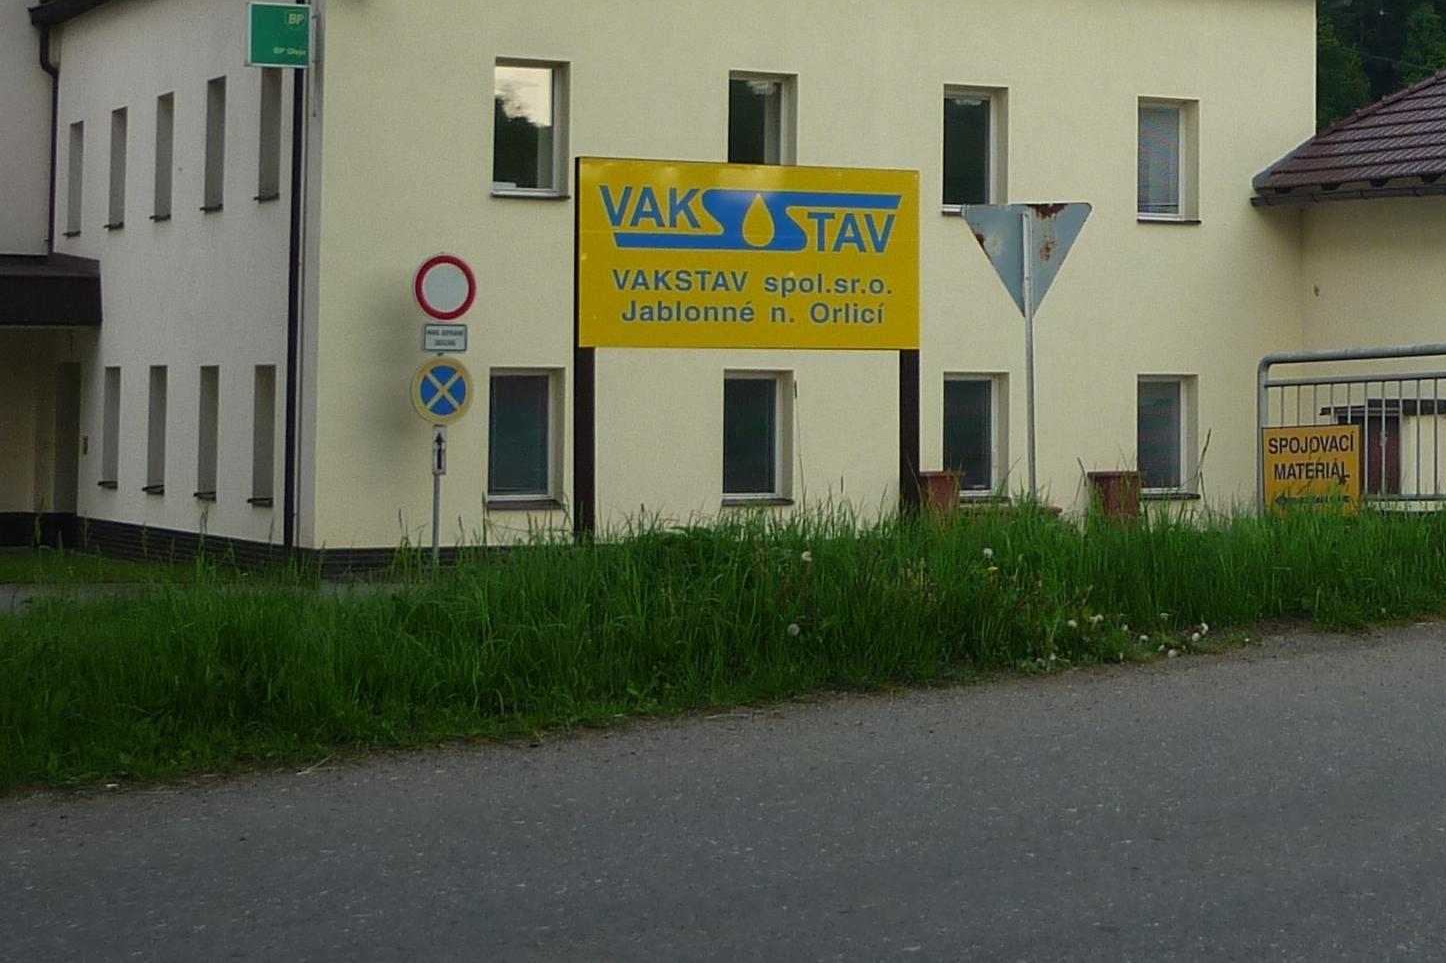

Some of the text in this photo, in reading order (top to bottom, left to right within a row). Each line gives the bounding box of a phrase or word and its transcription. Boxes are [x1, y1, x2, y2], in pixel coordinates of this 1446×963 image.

[288, 13, 305, 25] BP
[612, 269, 748, 292] VAKSTAV
[622, 300, 884, 325] Jablonné n. Orlicí
[1268, 430, 1355, 454] SPOJOVACÍ
[1274, 458, 1350, 481] MATERIÁL
